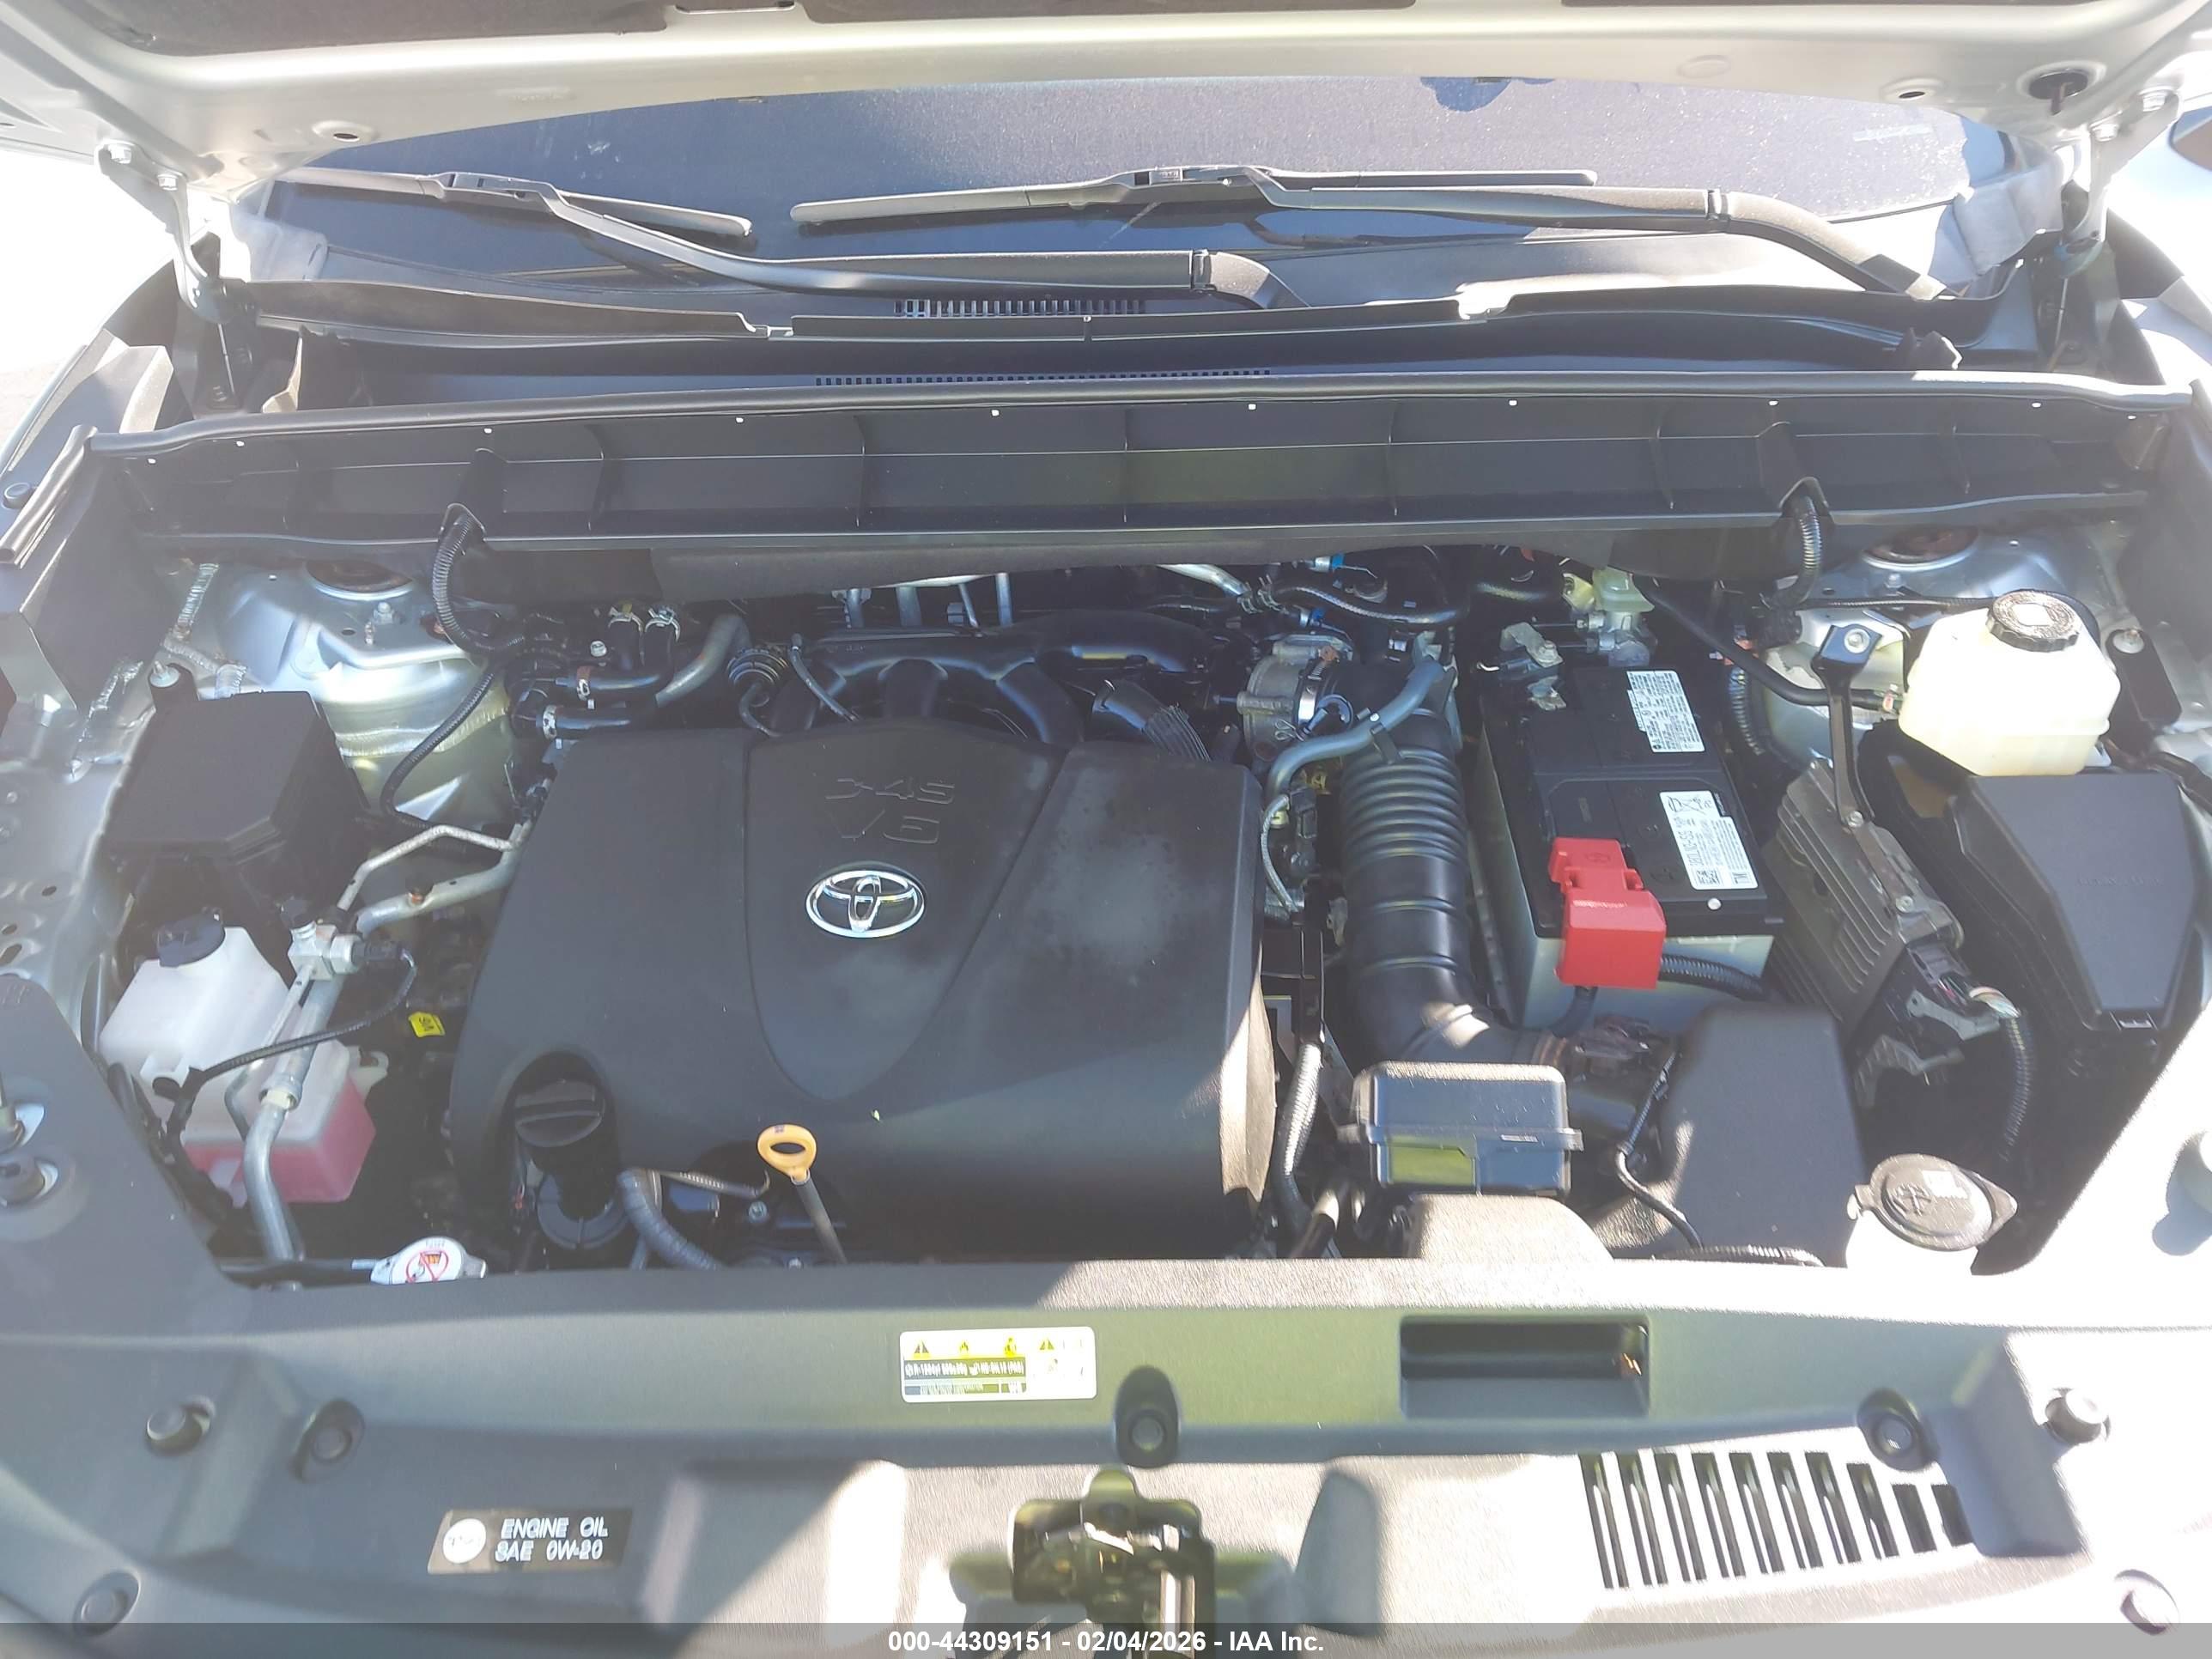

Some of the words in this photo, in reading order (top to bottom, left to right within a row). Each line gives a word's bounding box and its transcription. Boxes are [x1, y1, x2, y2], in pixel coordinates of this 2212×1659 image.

[826, 809, 940, 844] V6
[501, 1517, 569, 1539] ENGINE
[580, 1516, 609, 1537] OIL
[495, 1540, 534, 1562] SAE
[546, 1539, 603, 1561] 0W-20
